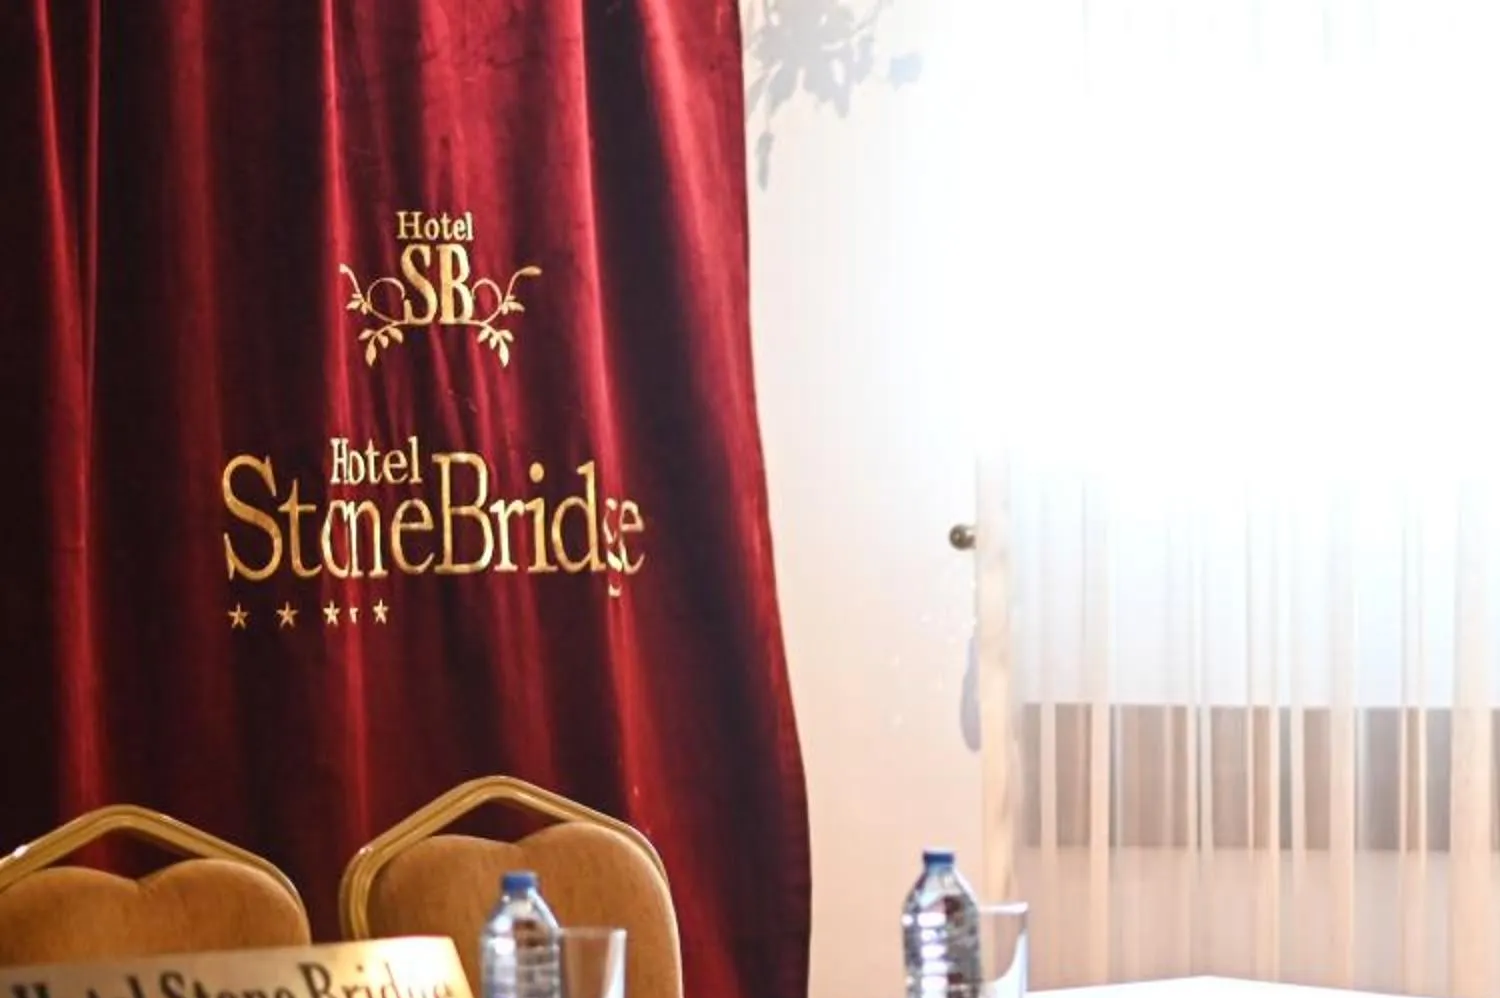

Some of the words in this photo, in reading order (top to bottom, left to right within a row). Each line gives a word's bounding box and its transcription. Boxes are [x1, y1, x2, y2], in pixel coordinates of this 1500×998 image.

[397, 211, 474, 241] Hotel
[401, 243, 475, 325] SB
[330, 436, 422, 486] Hotel
